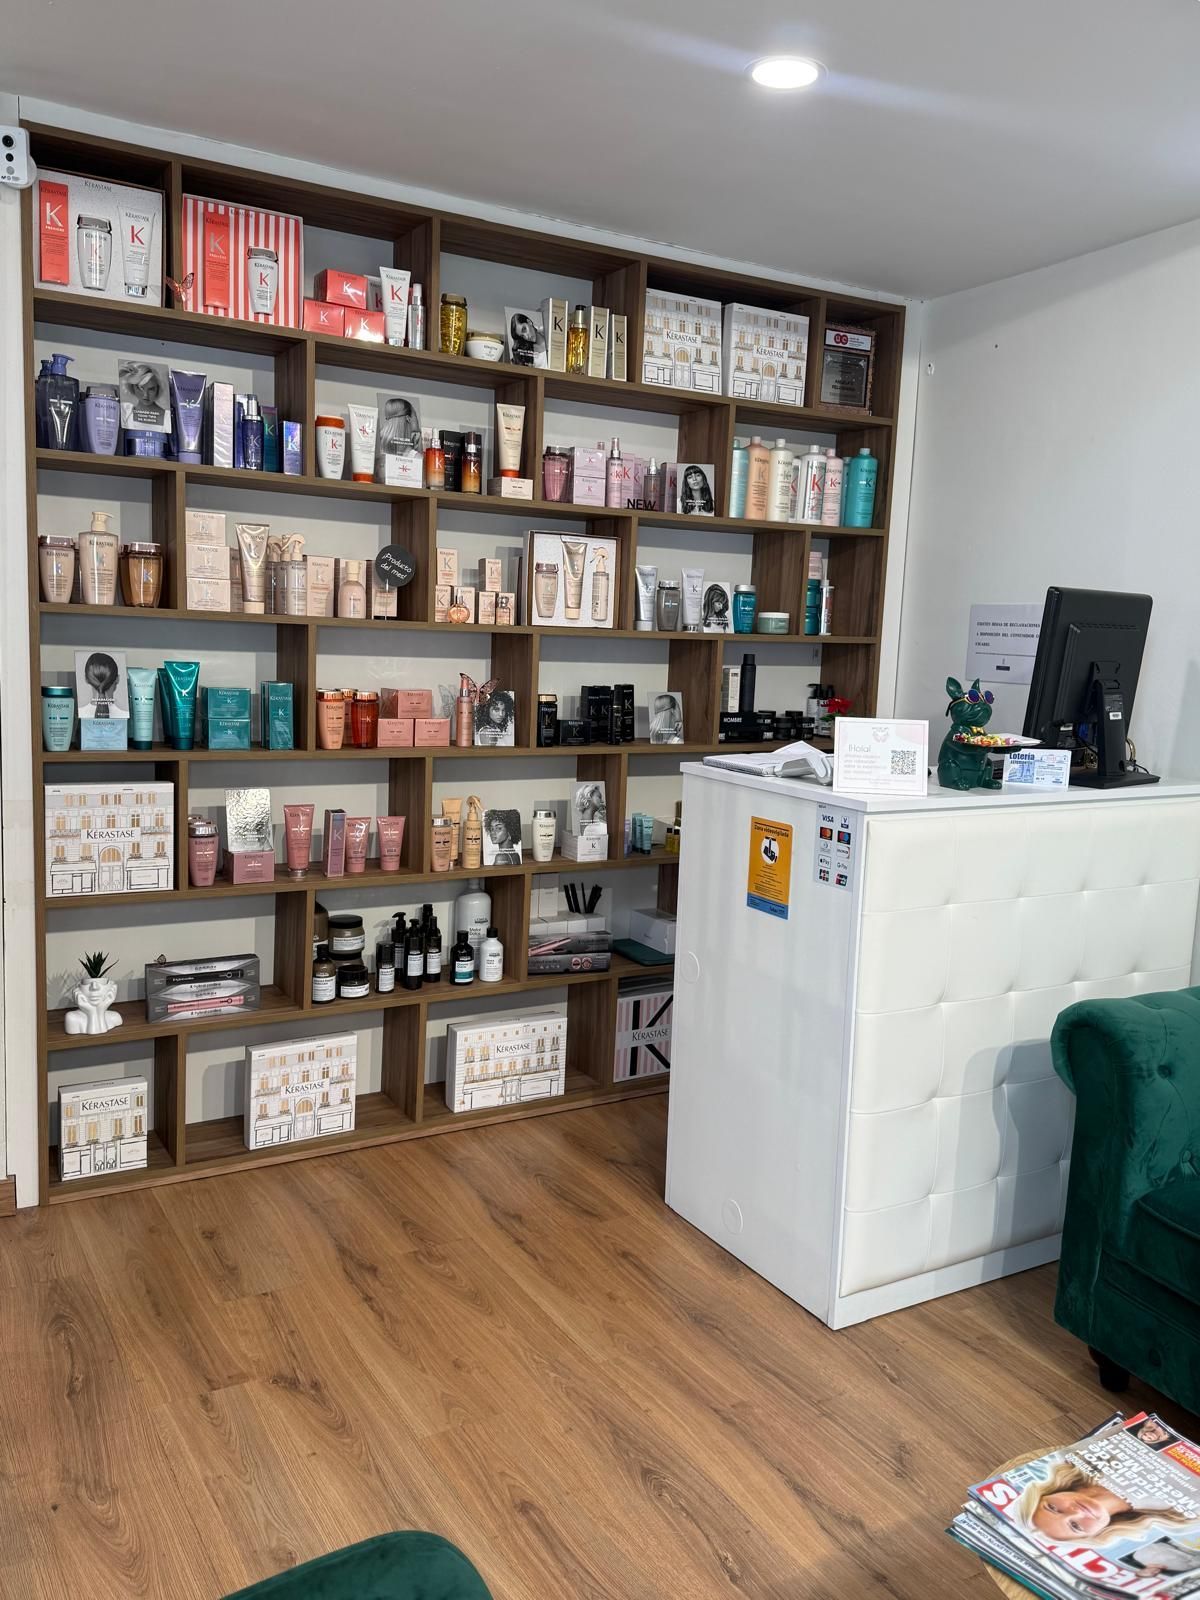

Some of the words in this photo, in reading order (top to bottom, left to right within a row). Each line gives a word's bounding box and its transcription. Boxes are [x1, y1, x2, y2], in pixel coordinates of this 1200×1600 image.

[46, 202, 63, 227] K
[130, 225, 144, 245] K
[210, 232, 224, 255] K
[260, 272, 270, 286] K
[391, 285, 402, 302] K
[320, 311, 328, 322] K
[361, 318, 369, 330] K
[554, 316, 563, 332] K
[595, 324, 604, 340] K
[616, 332, 623, 343] K
[266, 424, 274, 436] K
[331, 439, 338, 449] K
[436, 457, 442, 469] K
[471, 462, 477, 473] K
[624, 467, 630, 480] K
[812, 474, 822, 493] K
[830, 478, 836, 487] K
[627, 499, 656, 510] NEW
[381, 563, 391, 571] del
[443, 557, 451, 569] K
[437, 595, 445, 606] K
[625, 700, 631, 710] K
[1010, 752, 1035, 760] Lotería
[822, 814, 834, 822] VISA
[87, 830, 134, 839] KÉRASTASE
[334, 829, 342, 840] K
[632, 1028, 668, 1041] KÉRASTASE
[496, 1042, 531, 1054] KÉRASTASE
[285, 1082, 324, 1095] KÉRASTASE
[82, 1097, 128, 1111] KÉRASTASE
[1088, 1442, 1110, 1458] de
[1075, 1447, 1130, 1486] mayor
[1098, 1438, 1198, 1508] Mette-Marit
[1110, 1458, 1195, 1518] escándalo
[1127, 1485, 1149, 1500] El
